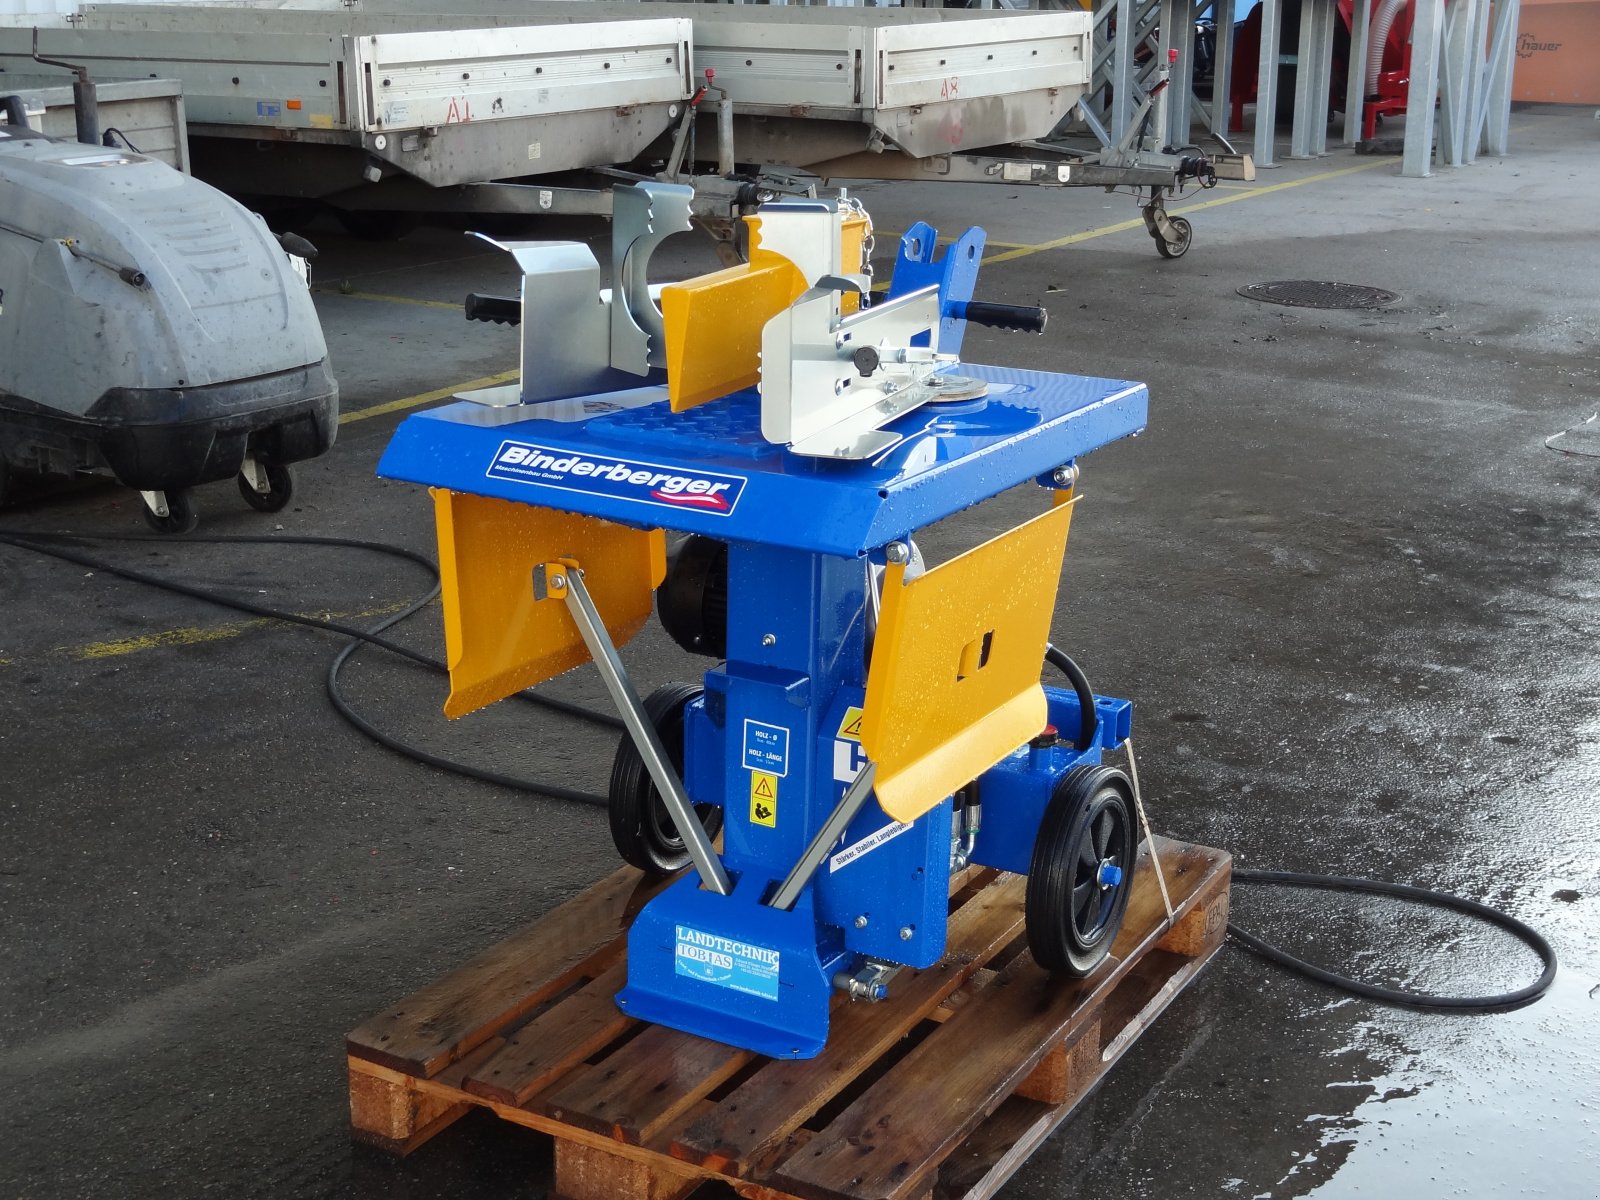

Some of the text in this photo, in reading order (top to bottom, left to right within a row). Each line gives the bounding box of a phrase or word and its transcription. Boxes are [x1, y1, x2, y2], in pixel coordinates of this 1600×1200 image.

[1521, 39, 1562, 51] hauer
[445, 96, 472, 125] A1
[494, 464, 564, 481] Maschinenbau GmbH
[499, 446, 731, 495] Binderberger
[755, 730, 769, 739] HOLZ
[748, 748, 762, 757] HOLZ
[766, 751, 782, 762] LÄNGE
[855, 838, 878, 854] Stabiler.
[677, 927, 779, 965] LANDTECHNIK
[679, 943, 731, 968] TOBIAS
